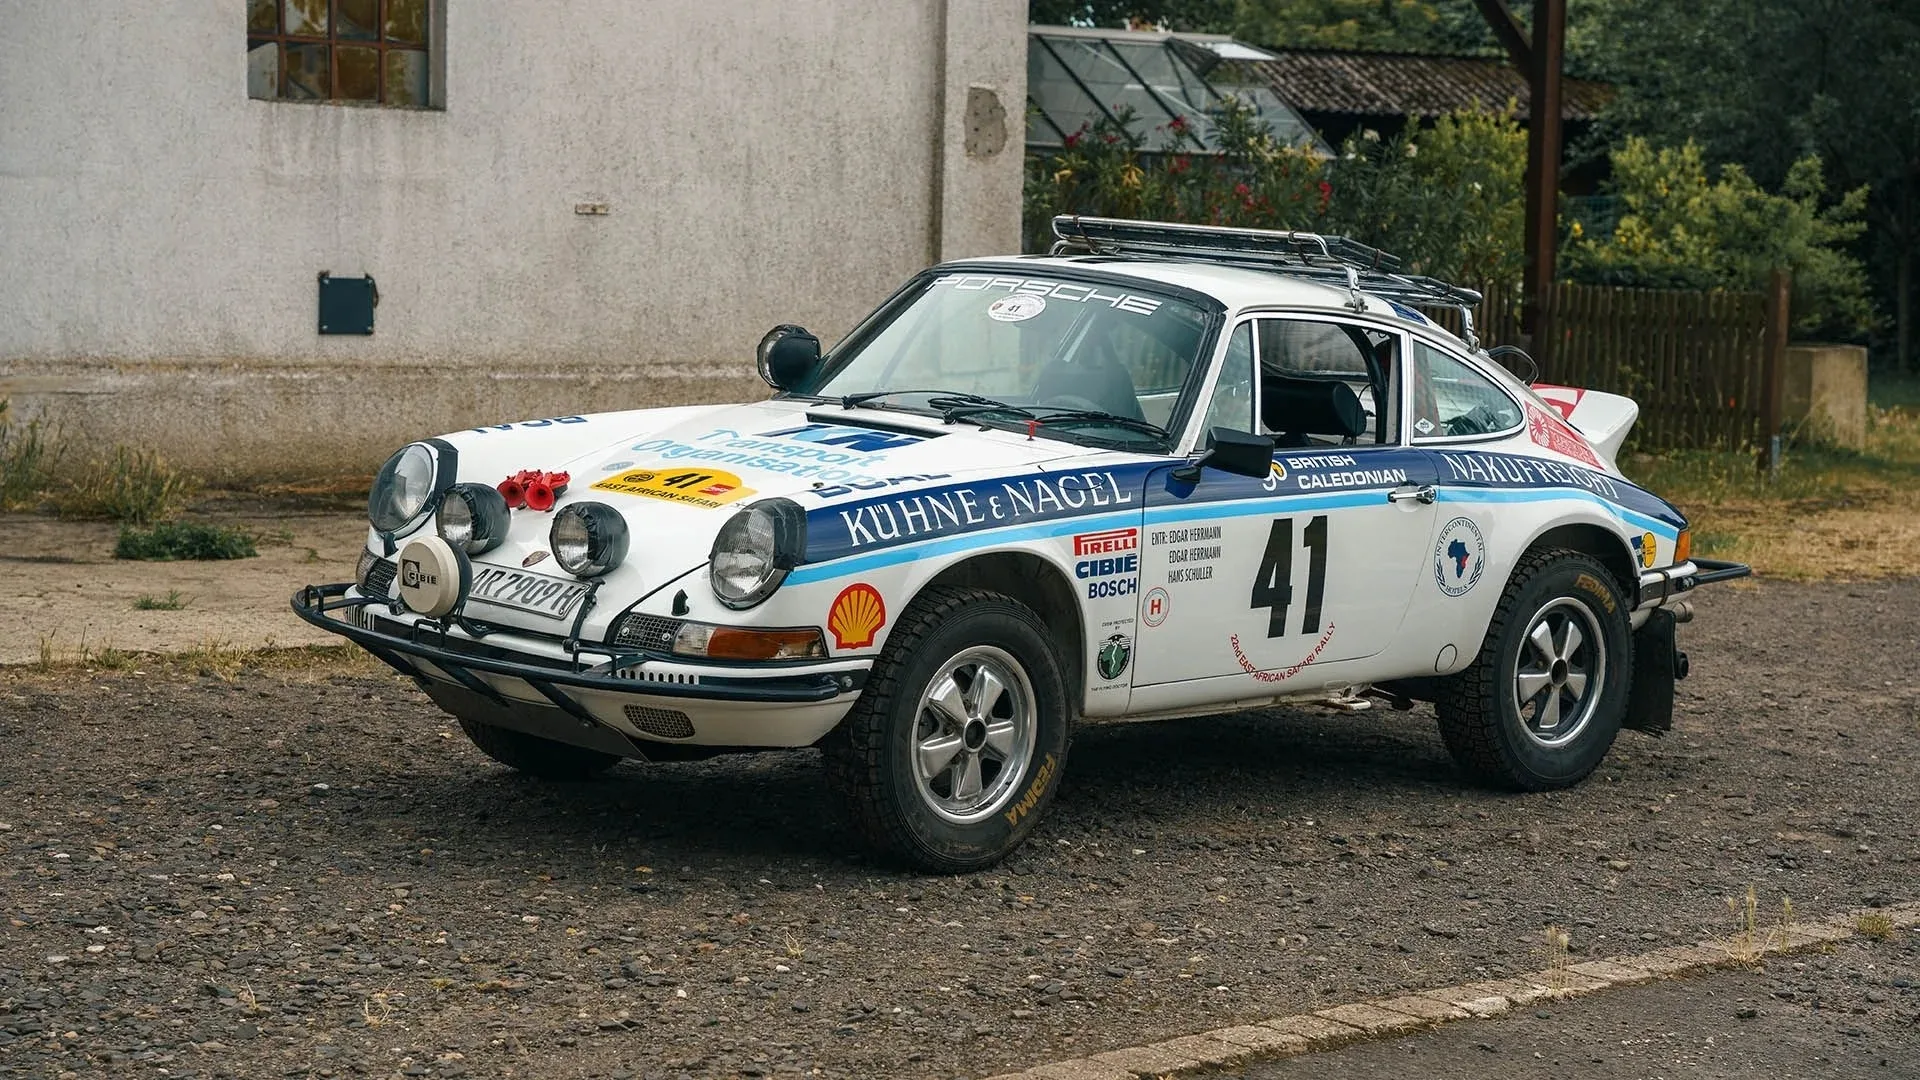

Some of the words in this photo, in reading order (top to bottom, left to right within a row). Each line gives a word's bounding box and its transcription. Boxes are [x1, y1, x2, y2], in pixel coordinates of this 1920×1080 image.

[927, 274, 1163, 316] PORSCHE
[632, 439, 877, 483] Organisation
[697, 429, 886, 467] Transport
[1288, 454, 1356, 470] BRITISH
[663, 473, 713, 489] 41
[1298, 469, 1408, 490] CALEDONIAN
[1443, 454, 1619, 499] NAKUFREIGHT
[595, 482, 627, 492] EAST
[628, 487, 679, 500] AFRICAN
[677, 493, 722, 509] SAFARI
[839, 489, 985, 548] KÜHNE
[1002, 472, 1133, 517] NAGEL
[1074, 528, 1137, 556] PIRELLI
[1169, 529, 1188, 544] EDGAR
[1190, 526, 1222, 541] HERRMANN
[1436, 519, 1483, 556] INTERCONTINENTAL
[1169, 549, 1188, 563] EDGAR
[1190, 546, 1221, 562] HERRMANN
[1088, 577, 1137, 599] BOSCH
[1168, 568, 1184, 583] HANS
[1250, 515, 1328, 638] 41
[1445, 583, 1468, 595] HOTELS
[1151, 599, 1161, 615] H
[1230, 633, 1243, 658] 22nd
[1238, 654, 1256, 674] EAST
[1252, 671, 1286, 682] AFRICAN
[1286, 653, 1316, 678] SAFARI
[1314, 621, 1335, 656] RALLY
[1004, 751, 1056, 826] FEDIMA
